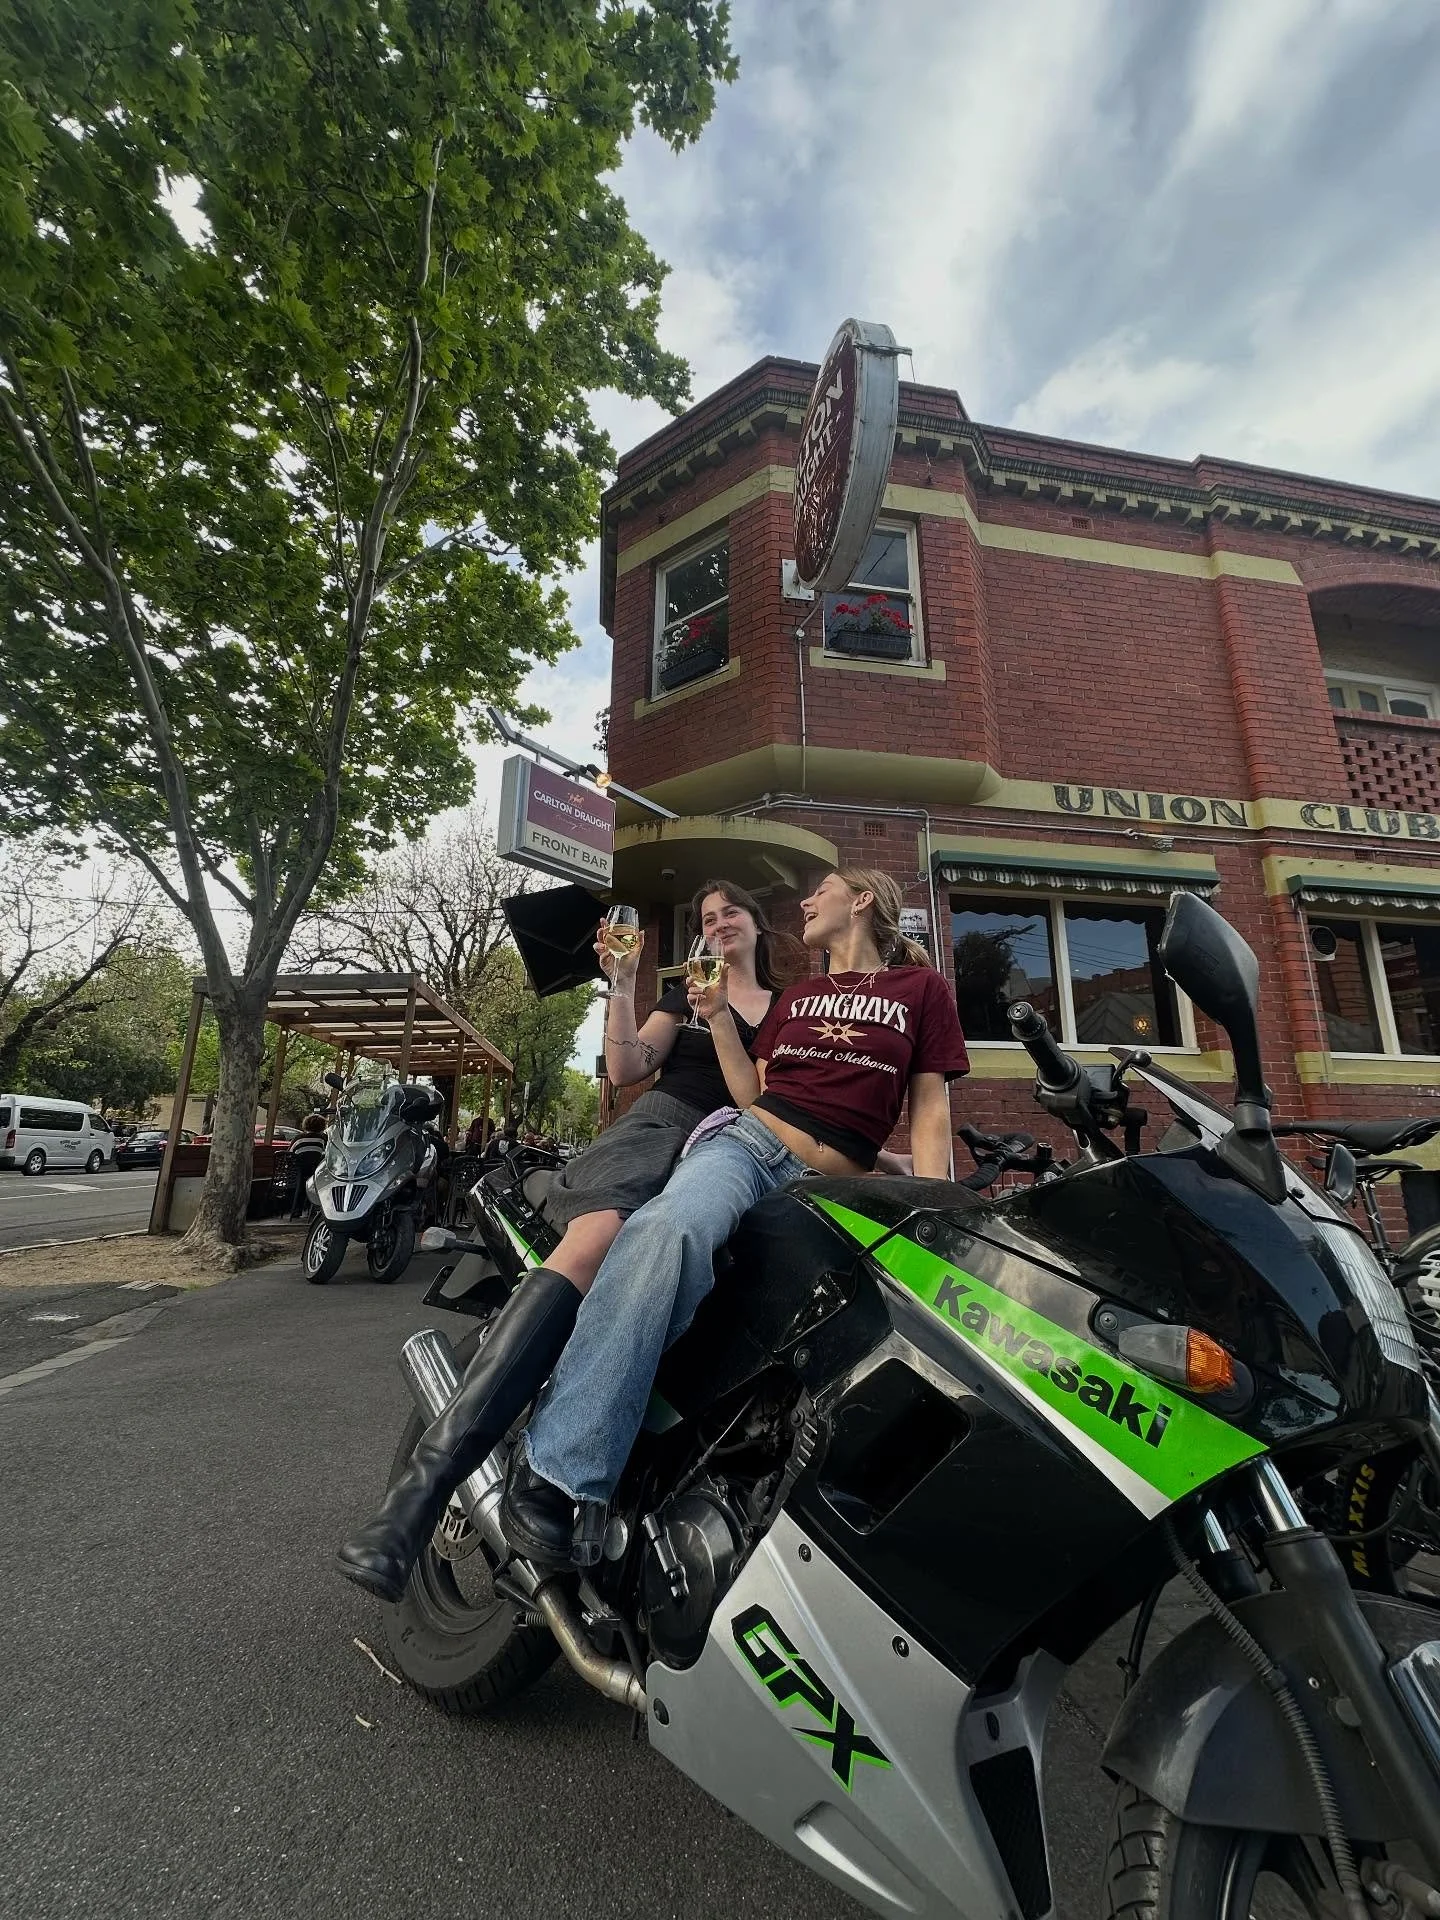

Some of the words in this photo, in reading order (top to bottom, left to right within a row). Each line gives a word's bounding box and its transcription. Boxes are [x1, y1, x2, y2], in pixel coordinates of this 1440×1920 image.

[533, 789, 572, 815] CARLTON
[575, 809, 611, 832] DRAUGHT
[1053, 784, 1247, 827] UNION
[1300, 803, 1440, 840] CLUB
[532, 831, 579, 858] FRONT
[582, 852, 608, 870] BAR
[788, 993, 909, 1034] STINGRAYS
[772, 1043, 832, 1061] Abbotsford
[933, 1275, 1172, 1448] Kawasaki
[731, 1603, 893, 1793] GPX
